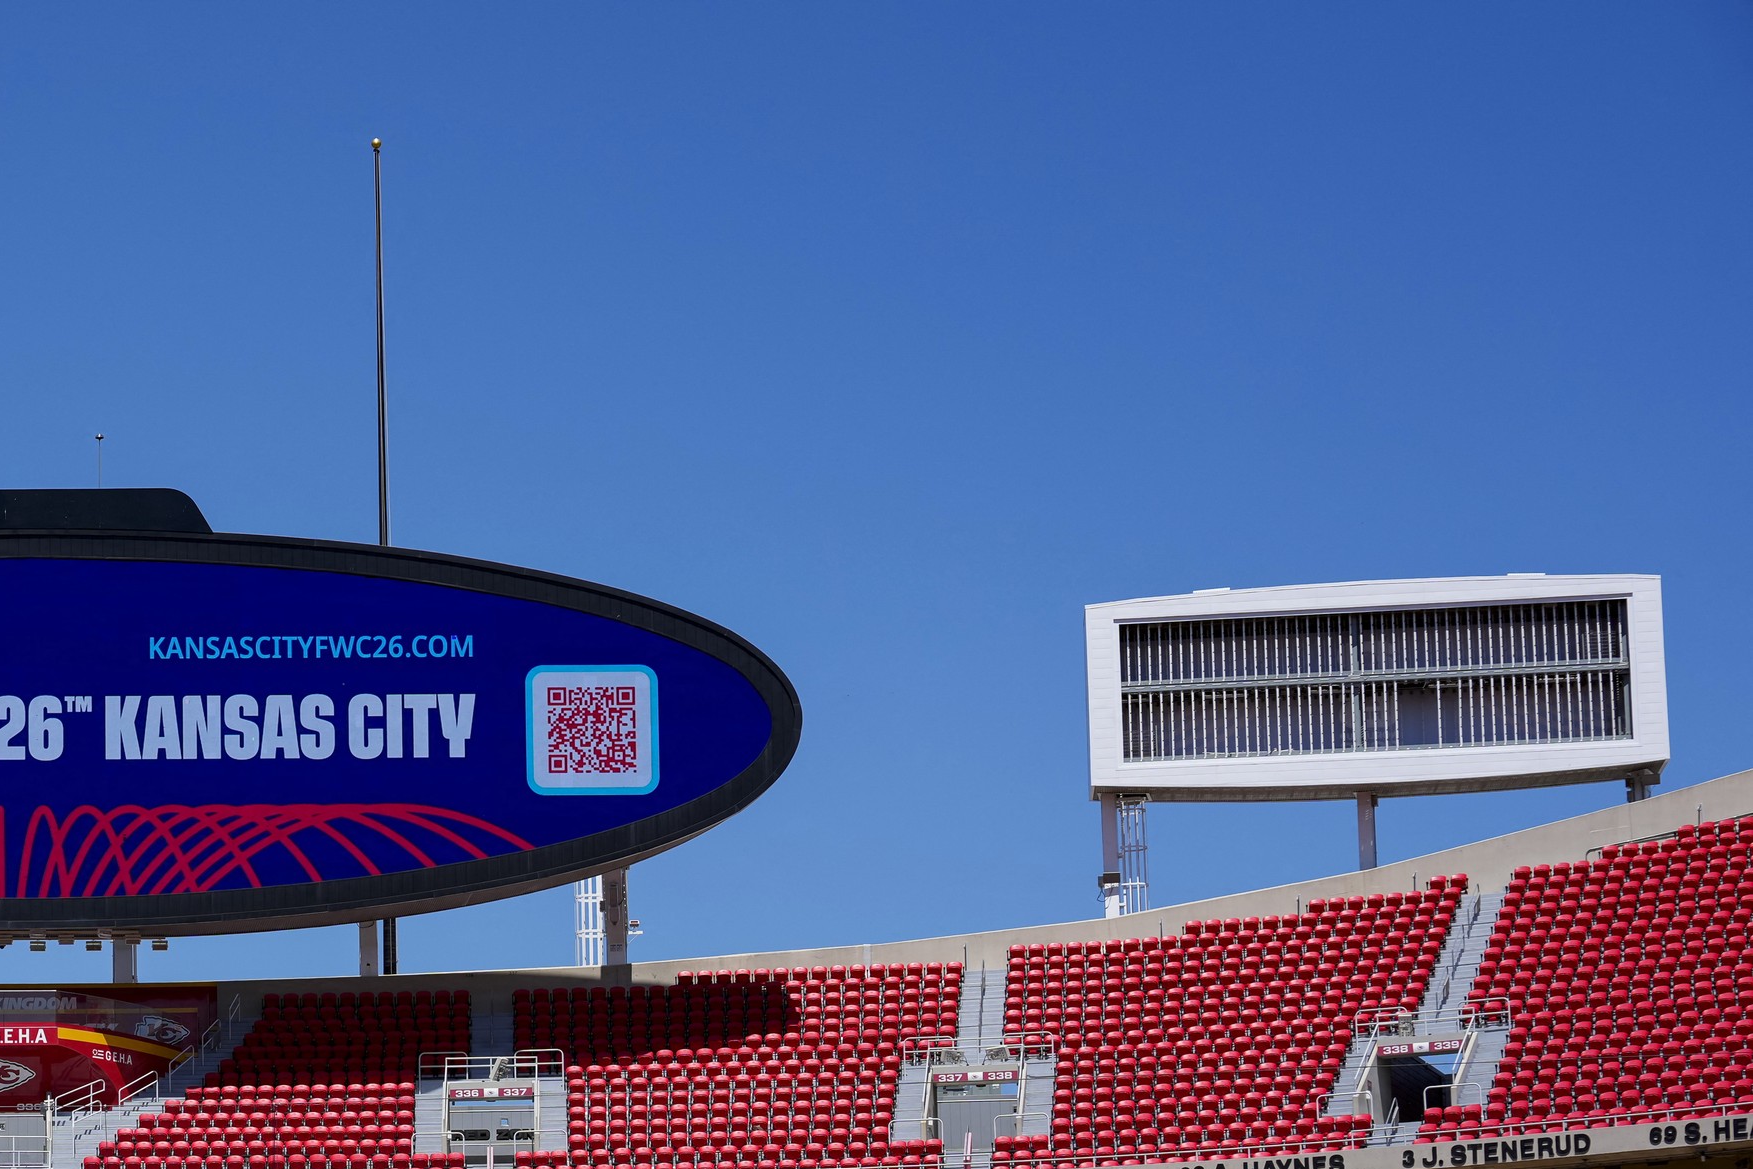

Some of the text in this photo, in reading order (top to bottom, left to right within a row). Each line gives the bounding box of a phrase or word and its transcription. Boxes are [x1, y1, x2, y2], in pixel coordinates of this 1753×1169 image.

[149, 635, 474, 660] KANSASCITYFWC26.COM
[104, 694, 336, 761] KANSAS
[348, 693, 476, 760] CITY
[1383, 1040, 1460, 1055] 338 339
[105, 1048, 133, 1066] GE.H.A
[938, 1071, 1013, 1082] 337 338
[455, 1088, 527, 1098] 336 337
[451, 1130, 491, 1141] RED
[1648, 1117, 1753, 1147] 69 S. HE
[1402, 1133, 1592, 1169] 3 J. STENERUD
